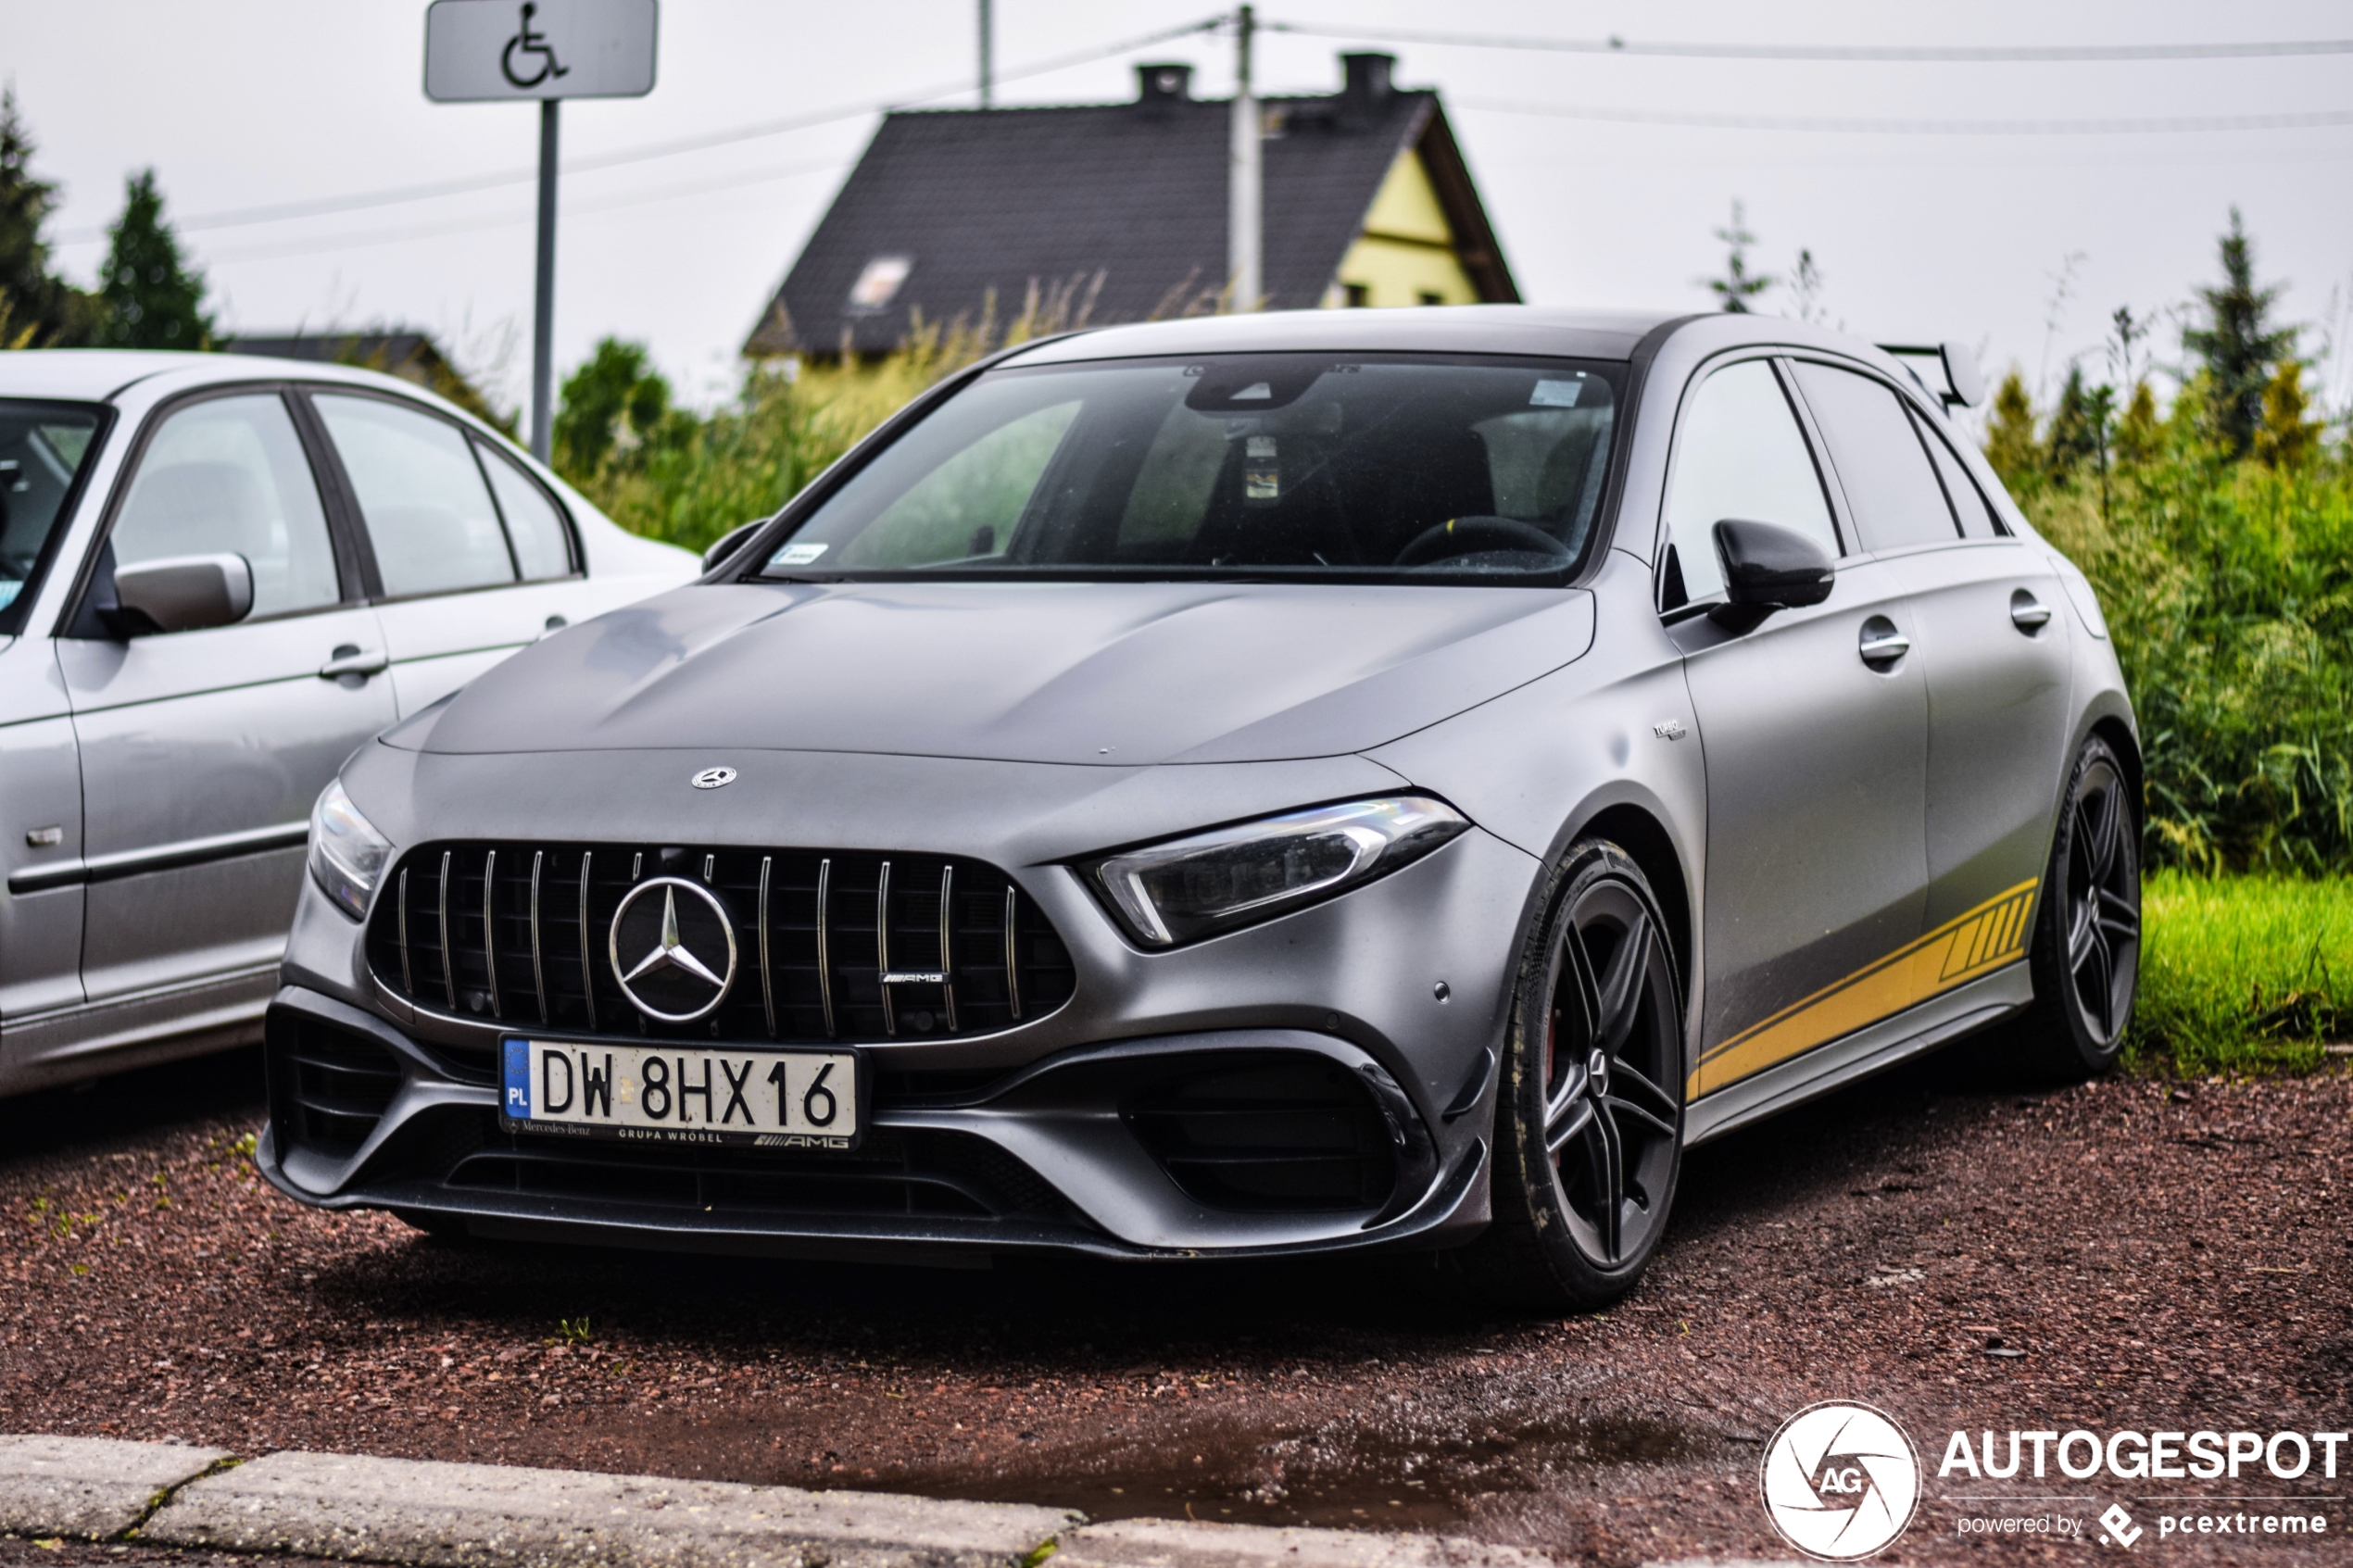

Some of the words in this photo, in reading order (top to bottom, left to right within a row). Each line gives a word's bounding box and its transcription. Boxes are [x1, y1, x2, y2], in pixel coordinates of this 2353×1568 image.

[902, 974, 943, 983] AMG
[543, 1049, 612, 1117] DW
[641, 1056, 837, 1127] 8HX16
[510, 1087, 527, 1106] PL
[522, 1120, 591, 1136] Mercedes-Benz
[619, 1128, 661, 1140] GRUPA
[668, 1131, 723, 1143] WRÓBEL
[784, 1135, 849, 1149] AMG
